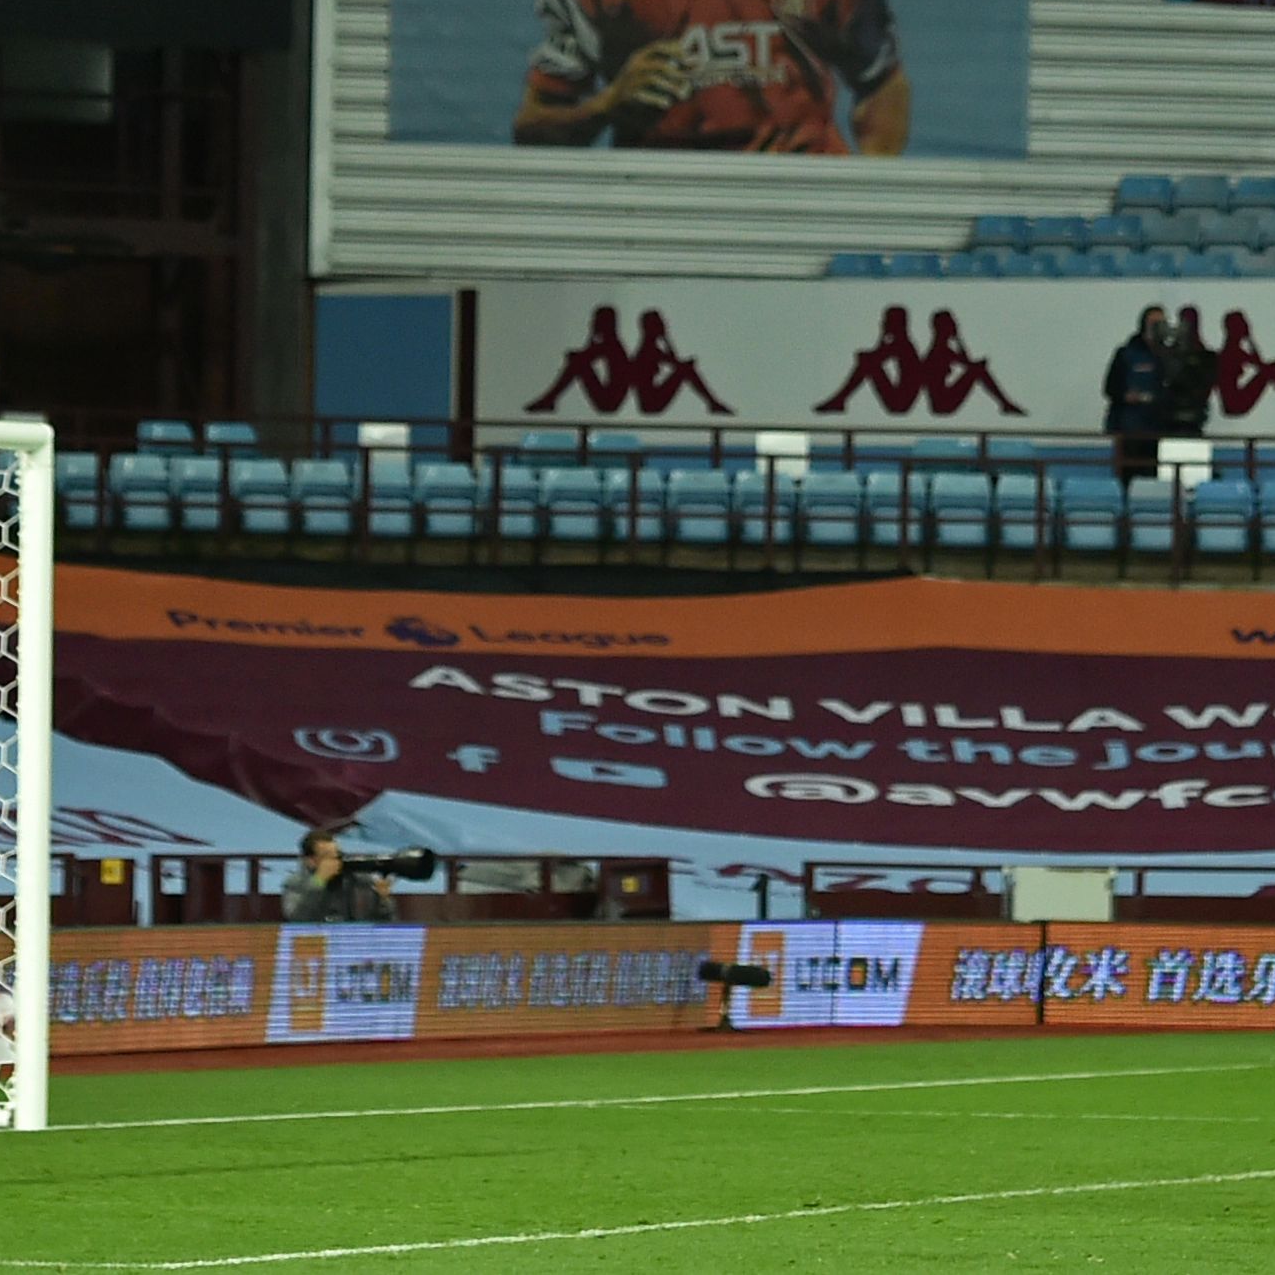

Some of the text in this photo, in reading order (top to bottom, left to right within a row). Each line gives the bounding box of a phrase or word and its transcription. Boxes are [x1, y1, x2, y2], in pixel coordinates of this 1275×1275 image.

[166, 610, 671, 649] Premier League
[408, 665, 795, 721] ASTON
[818, 697, 1146, 732] VILLA
[538, 711, 877, 760] Follow
[898, 736, 1079, 767] the
